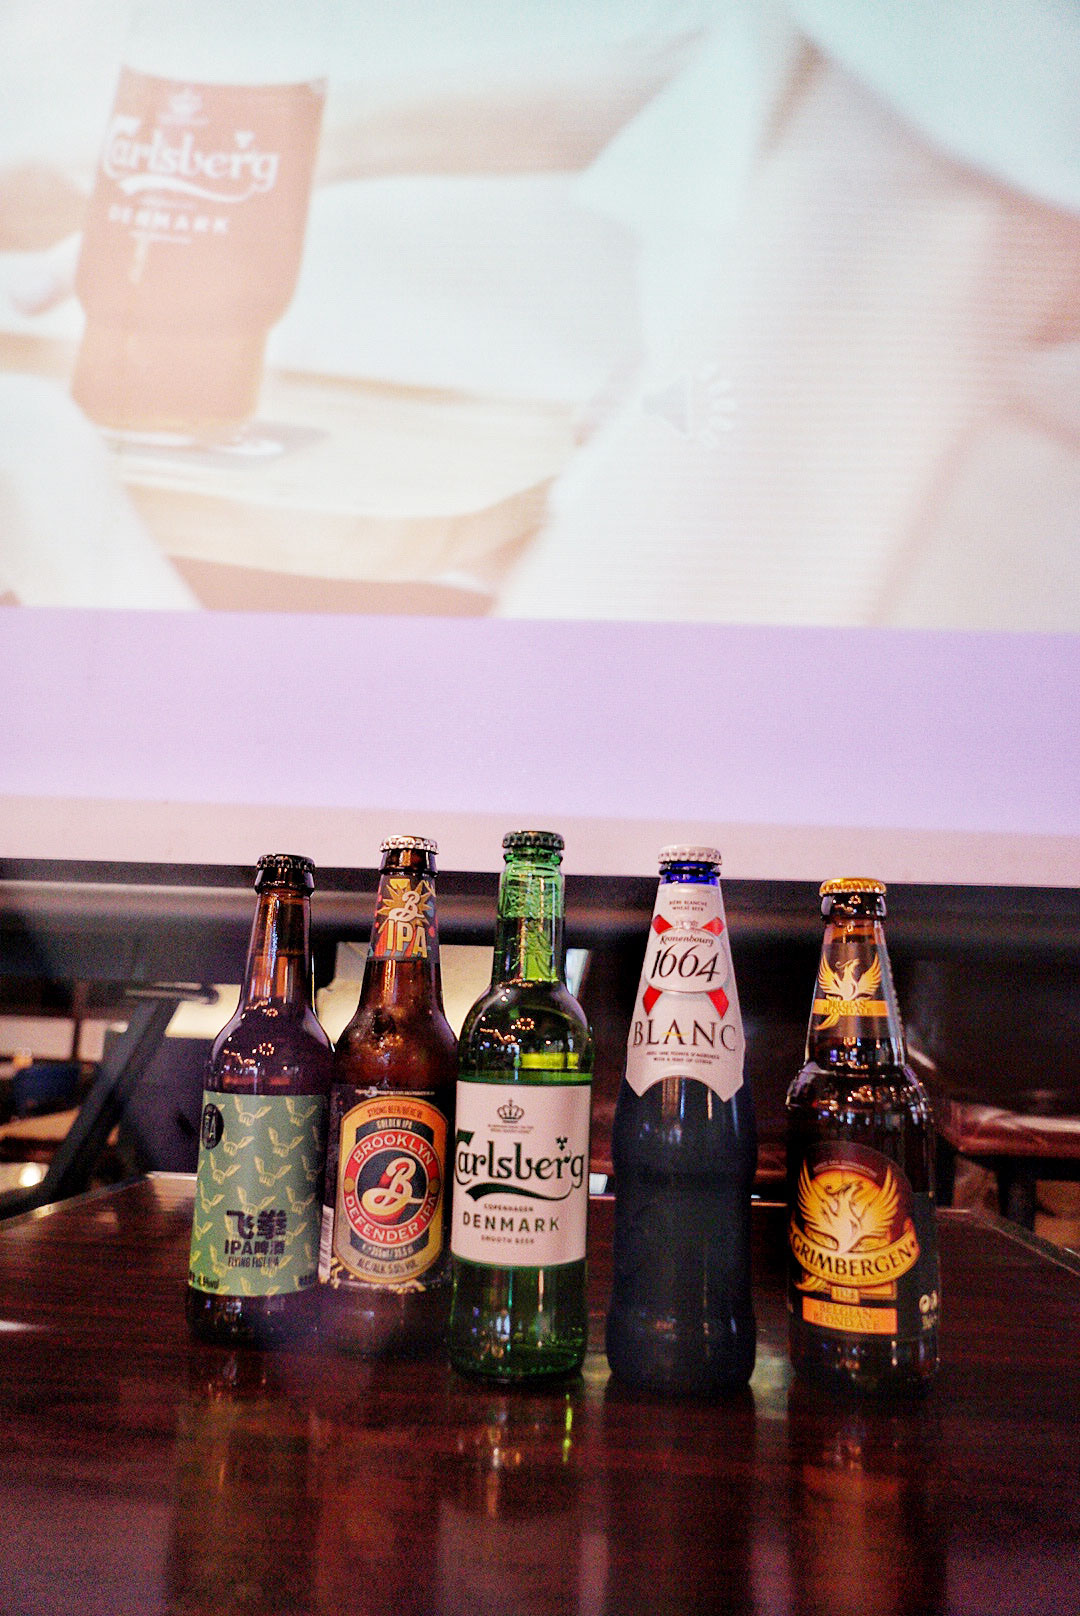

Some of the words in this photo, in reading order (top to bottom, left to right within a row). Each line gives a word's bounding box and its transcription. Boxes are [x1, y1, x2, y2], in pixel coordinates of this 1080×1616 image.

[102, 114, 279, 196] Carlsberg
[386, 919, 428, 959] IPA
[660, 934, 714, 947] Kronenbourg
[650, 943, 720, 983] 1664
[633, 1018, 736, 1052] BLANC
[353, 1133, 434, 1165] BROOKLYN
[454, 1128, 586, 1191] Carlsberg
[345, 1195, 419, 1242] DEFENDER
[420, 1195, 437, 1222] IPA
[463, 1211, 560, 1232] DENMARK
[792, 1233, 912, 1277] GRIMBERGEN
